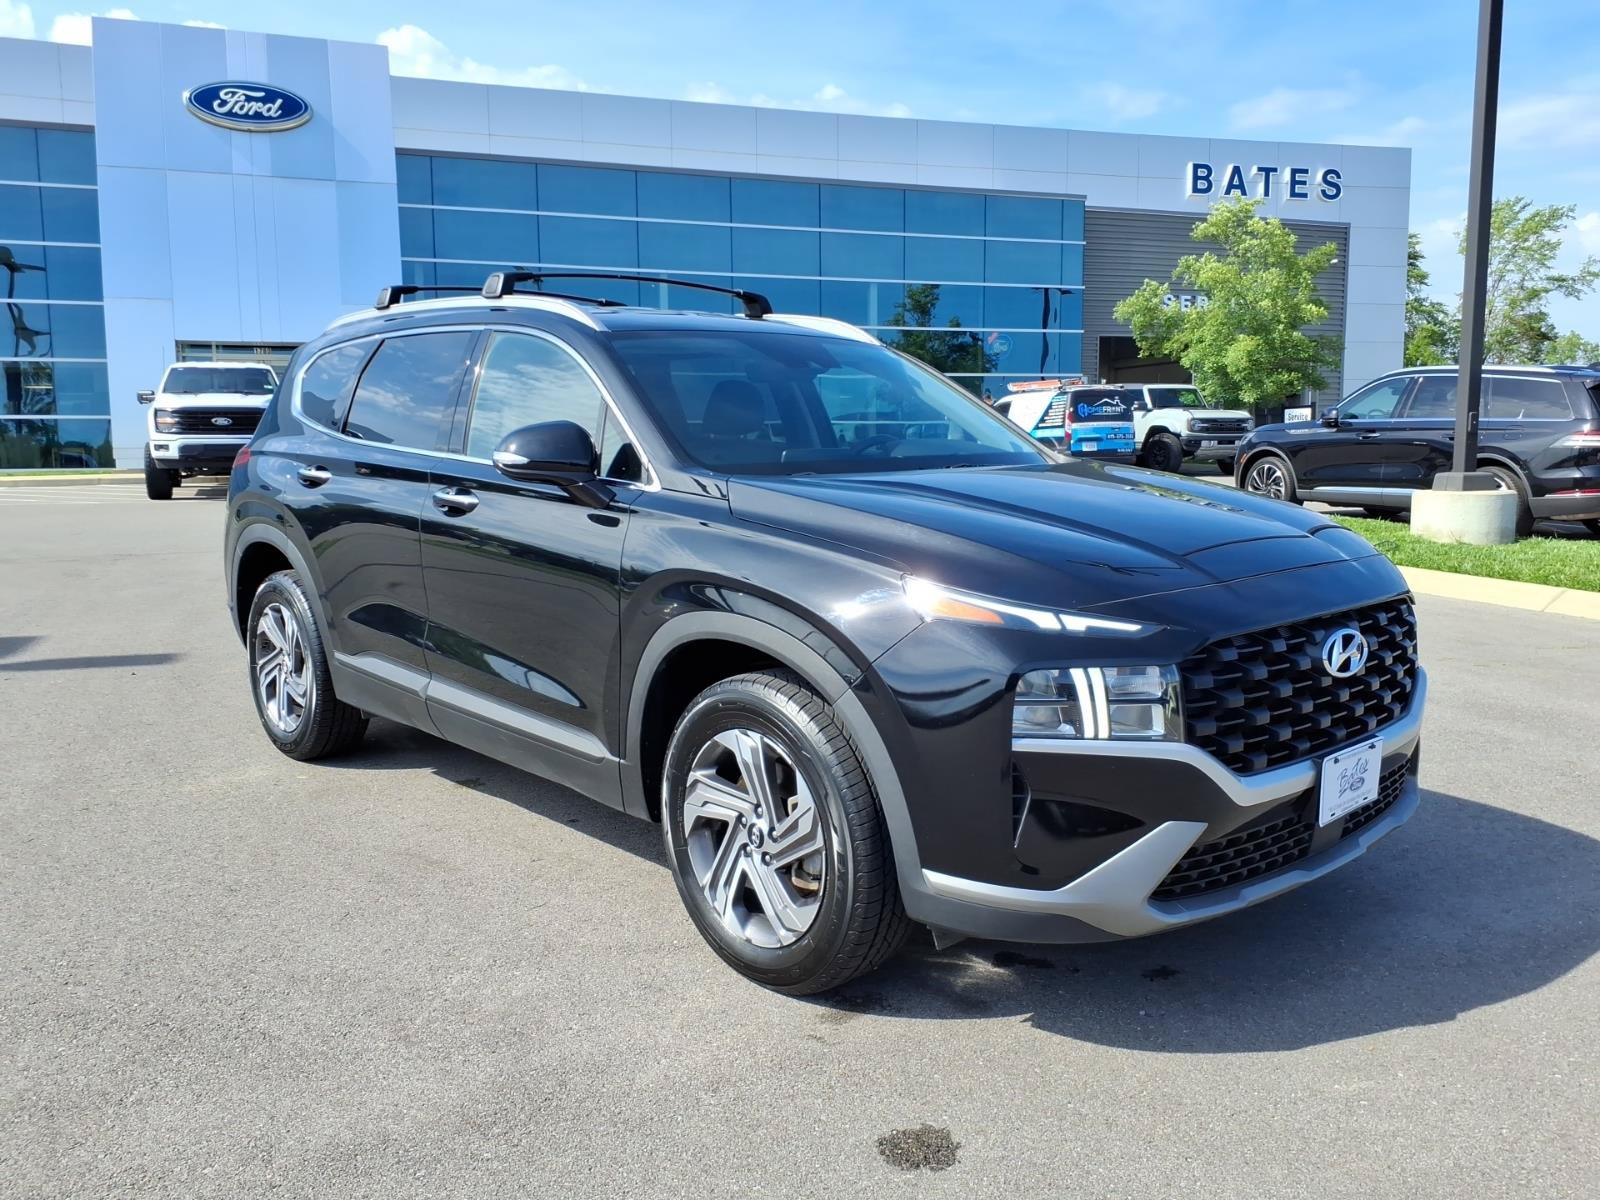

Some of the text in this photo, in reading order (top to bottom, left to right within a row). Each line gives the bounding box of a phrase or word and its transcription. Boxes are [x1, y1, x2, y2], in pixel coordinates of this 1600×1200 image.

[213, 88, 283, 118] Ford
[1188, 162, 1343, 201] BATES
[1288, 413, 1309, 422] Service
